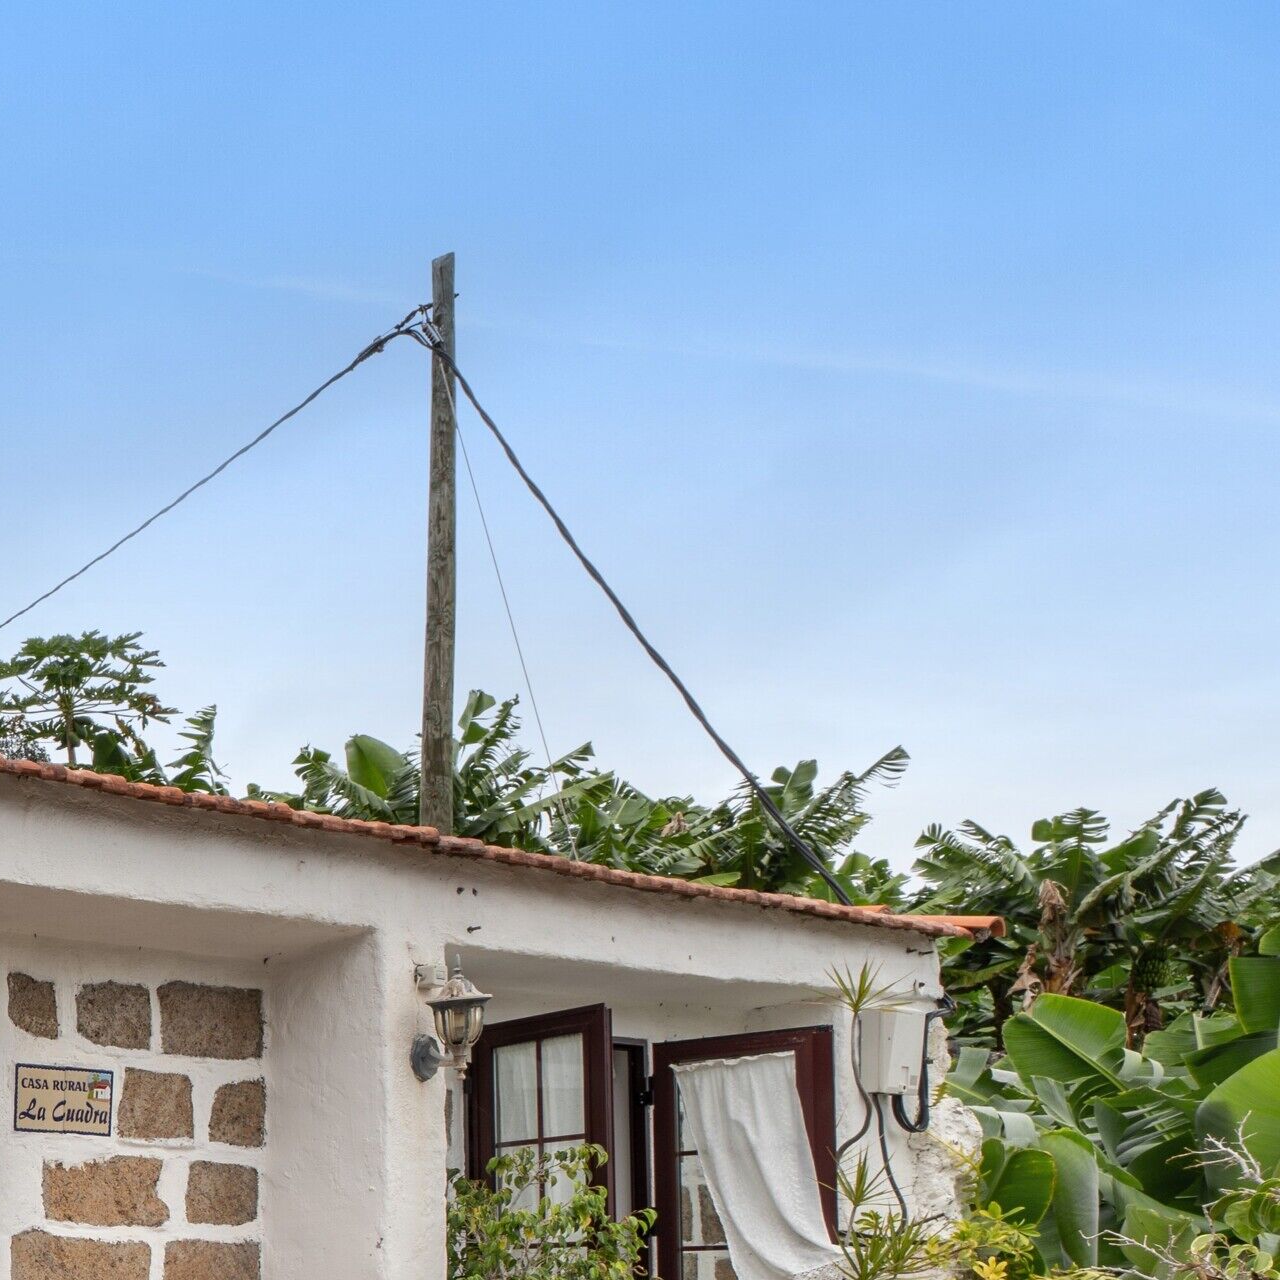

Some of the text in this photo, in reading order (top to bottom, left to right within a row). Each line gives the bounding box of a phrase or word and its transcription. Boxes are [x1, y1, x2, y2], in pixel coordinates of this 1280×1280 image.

[21, 1077, 88, 1092] CASA RURAL
[18, 1098, 108, 1124] La Cuadra
